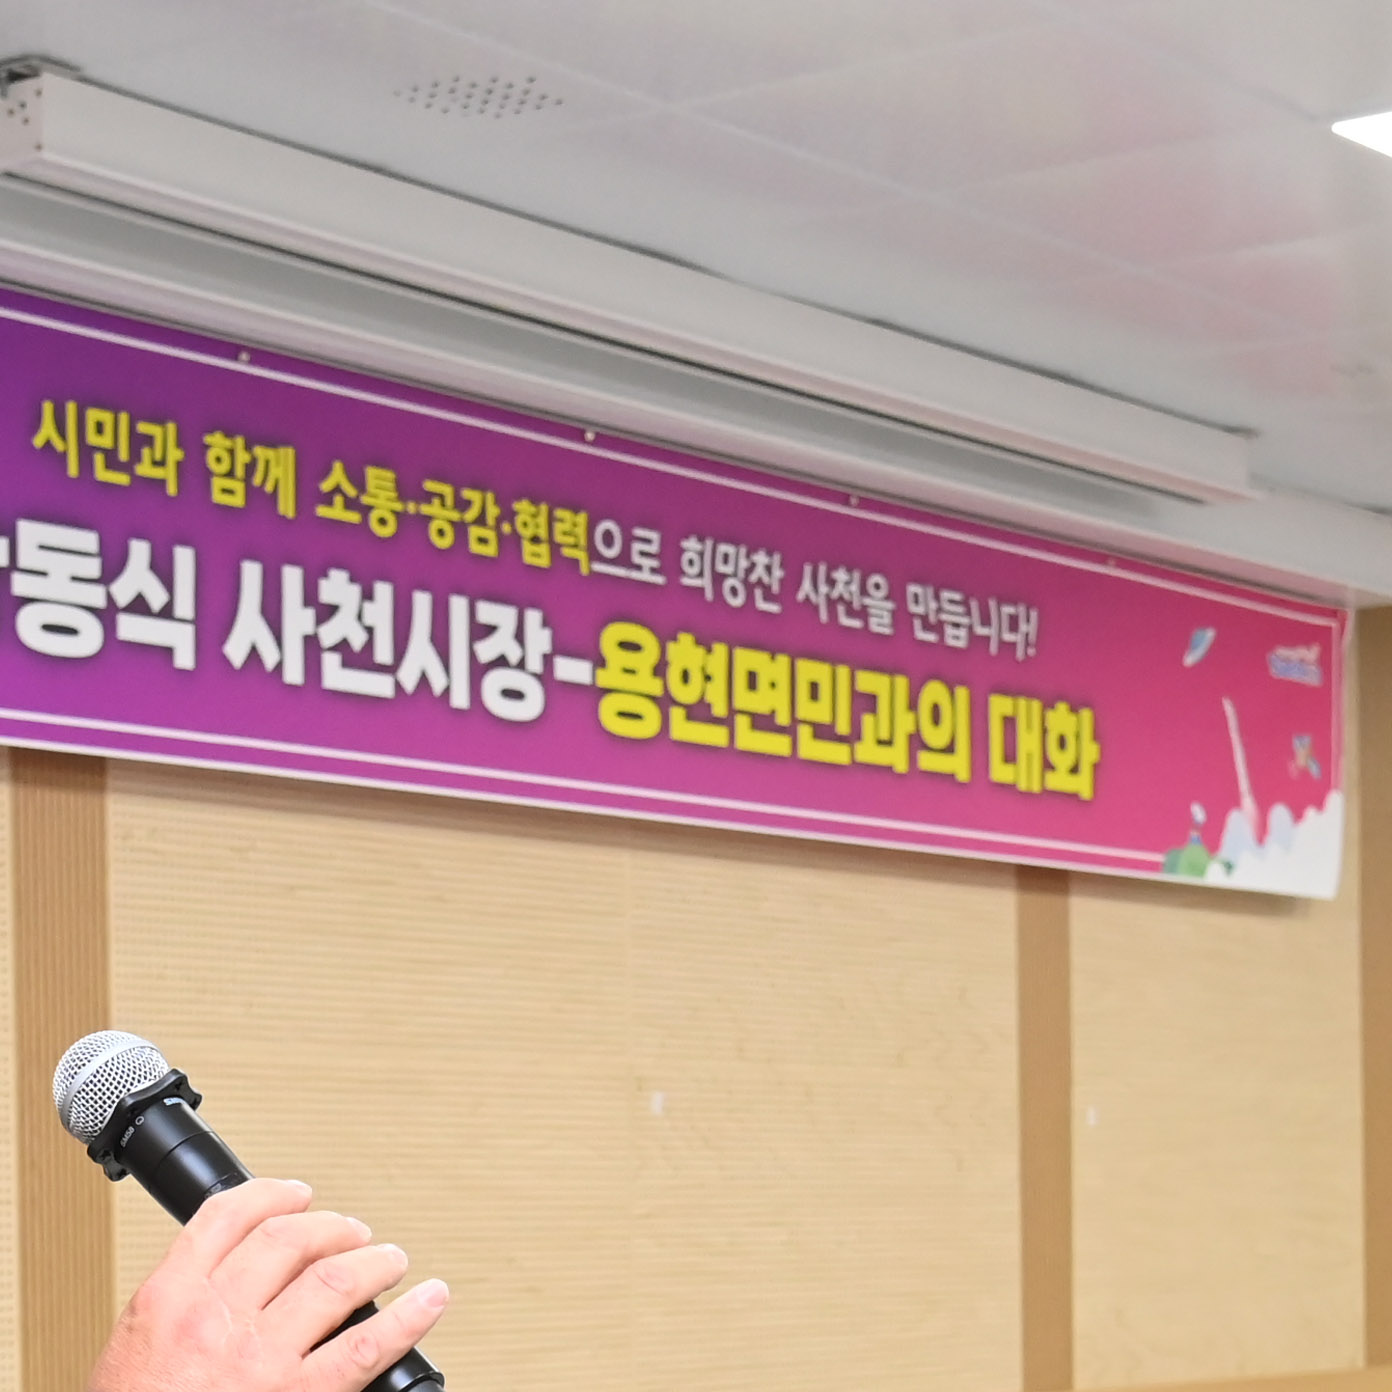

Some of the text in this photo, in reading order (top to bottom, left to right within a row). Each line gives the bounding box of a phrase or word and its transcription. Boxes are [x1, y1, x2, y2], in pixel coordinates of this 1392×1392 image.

[32, 400, 184, 496] 시민과
[203, 431, 295, 518] 함께
[680, 535, 785, 614] 희망찬
[796, 564, 895, 636] 사천을
[906, 584, 1038, 660] 만듭니다!
[988, 694, 1100, 801] 대화
